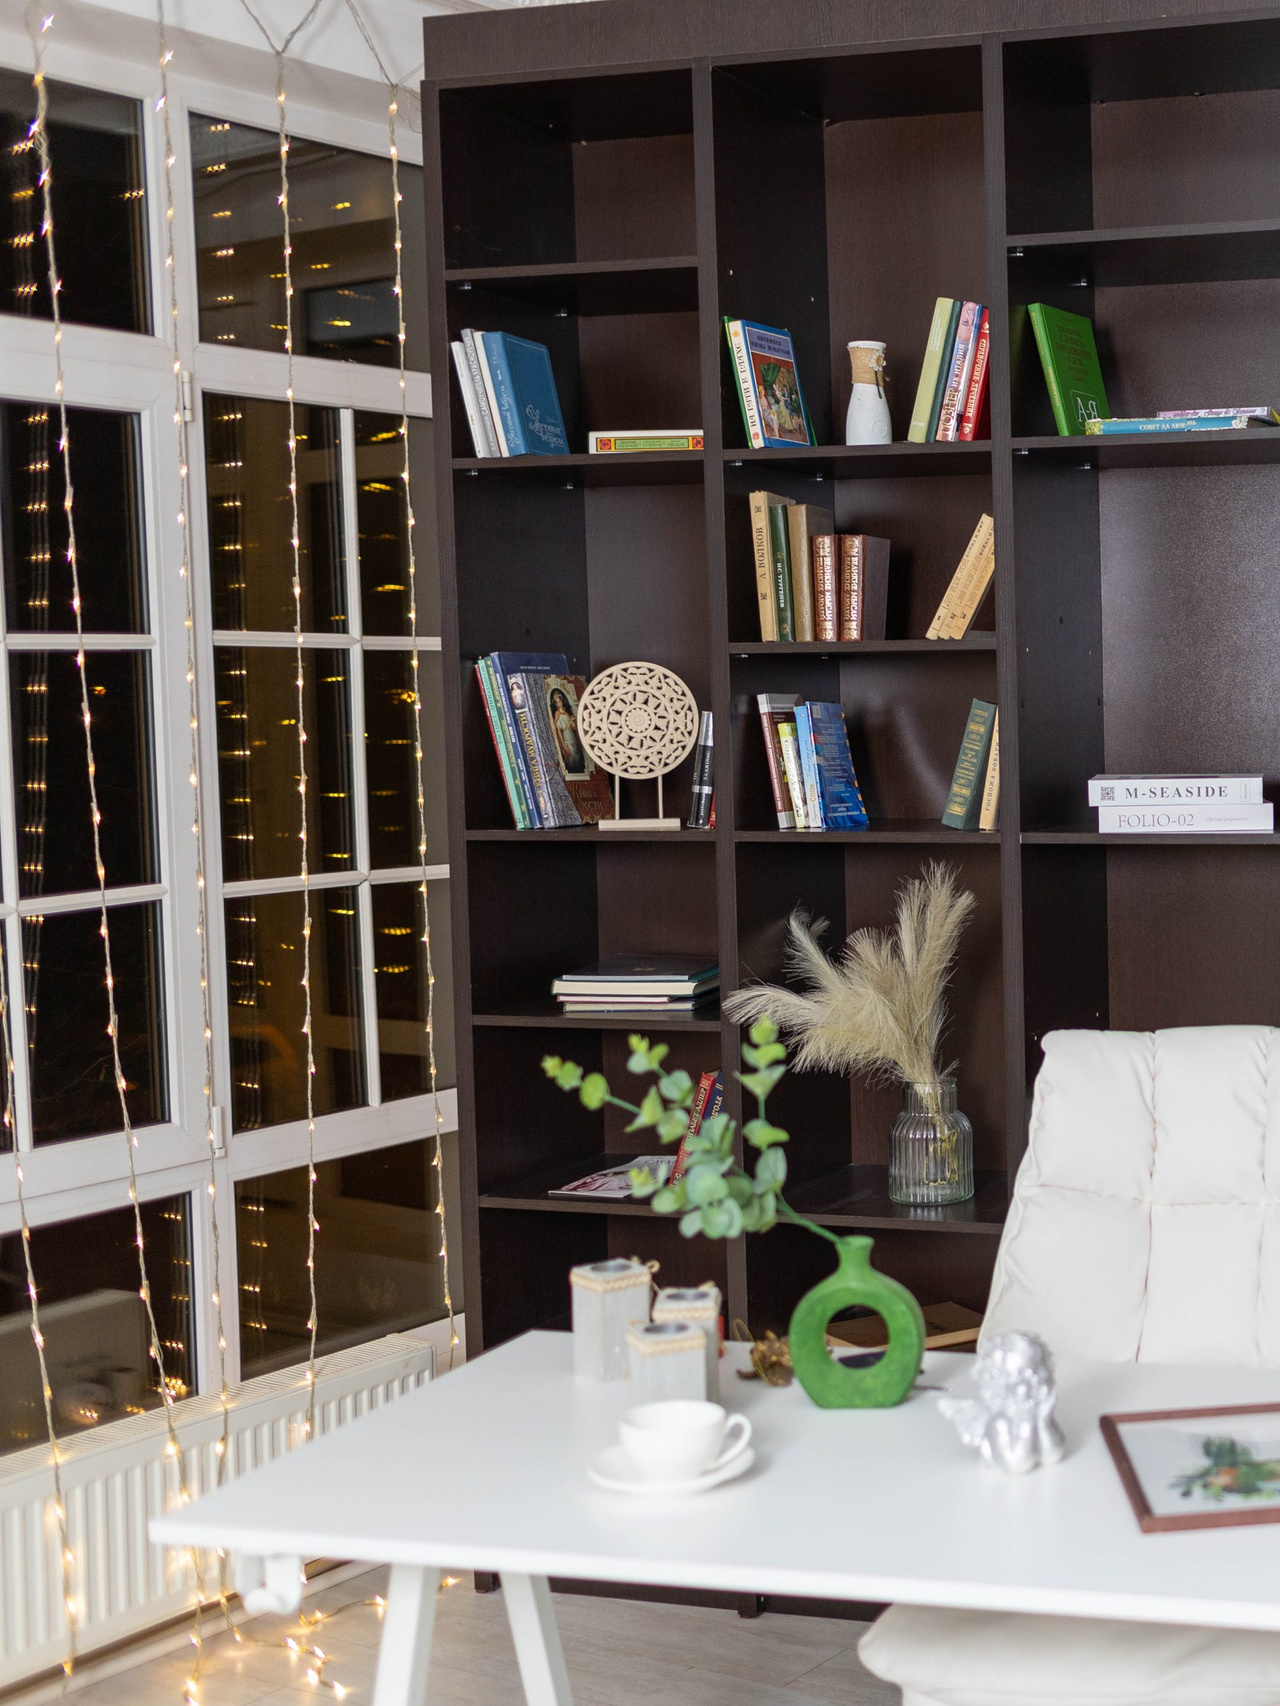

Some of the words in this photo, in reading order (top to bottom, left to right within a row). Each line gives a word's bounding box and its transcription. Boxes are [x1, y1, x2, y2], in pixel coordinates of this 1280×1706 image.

[464, 335, 478, 375] КРАСНОРЕЧИЯ
[733, 342, 746, 373] ПЛАХЕ
[953, 342, 966, 374] ИТАЛИЯ
[474, 375, 489, 415] САМОУЧИТЕЛЬ
[951, 376, 959, 387] ИХ
[742, 385, 754, 411] ПУТИ
[939, 387, 959, 435] ПОЗНЕР
[1078, 397, 1097, 422] А-Я
[748, 413, 757, 427] НА
[1139, 423, 1160, 432] СОВЕТ
[1161, 422, 1171, 431] ДА
[756, 527, 766, 568] ВОЛКОВ
[758, 569, 766, 579] А.
[817, 557, 825, 590] ВЕЛИКИХ
[823, 556, 832, 590] ВЕЛИКИЕ
[777, 574, 785, 607] ТУРГЕНЕВ
[824, 591, 833, 620] МЫСЛИ
[850, 591, 858, 620] МЫСЛИ
[481, 664, 497, 712] ДИНОЗАВРОВ
[491, 714, 503, 744] РАСЦВЕТ
[519, 712, 536, 758] МУДРОСТИ
[531, 759, 542, 787] КНИГА
[984, 774, 995, 811] ГОСПОЖА
[1125, 785, 1228, 799] M-SEASIDE
[1118, 813, 1194, 828] FOLIO-02
[694, 1086, 706, 1112] АДЛЕР
